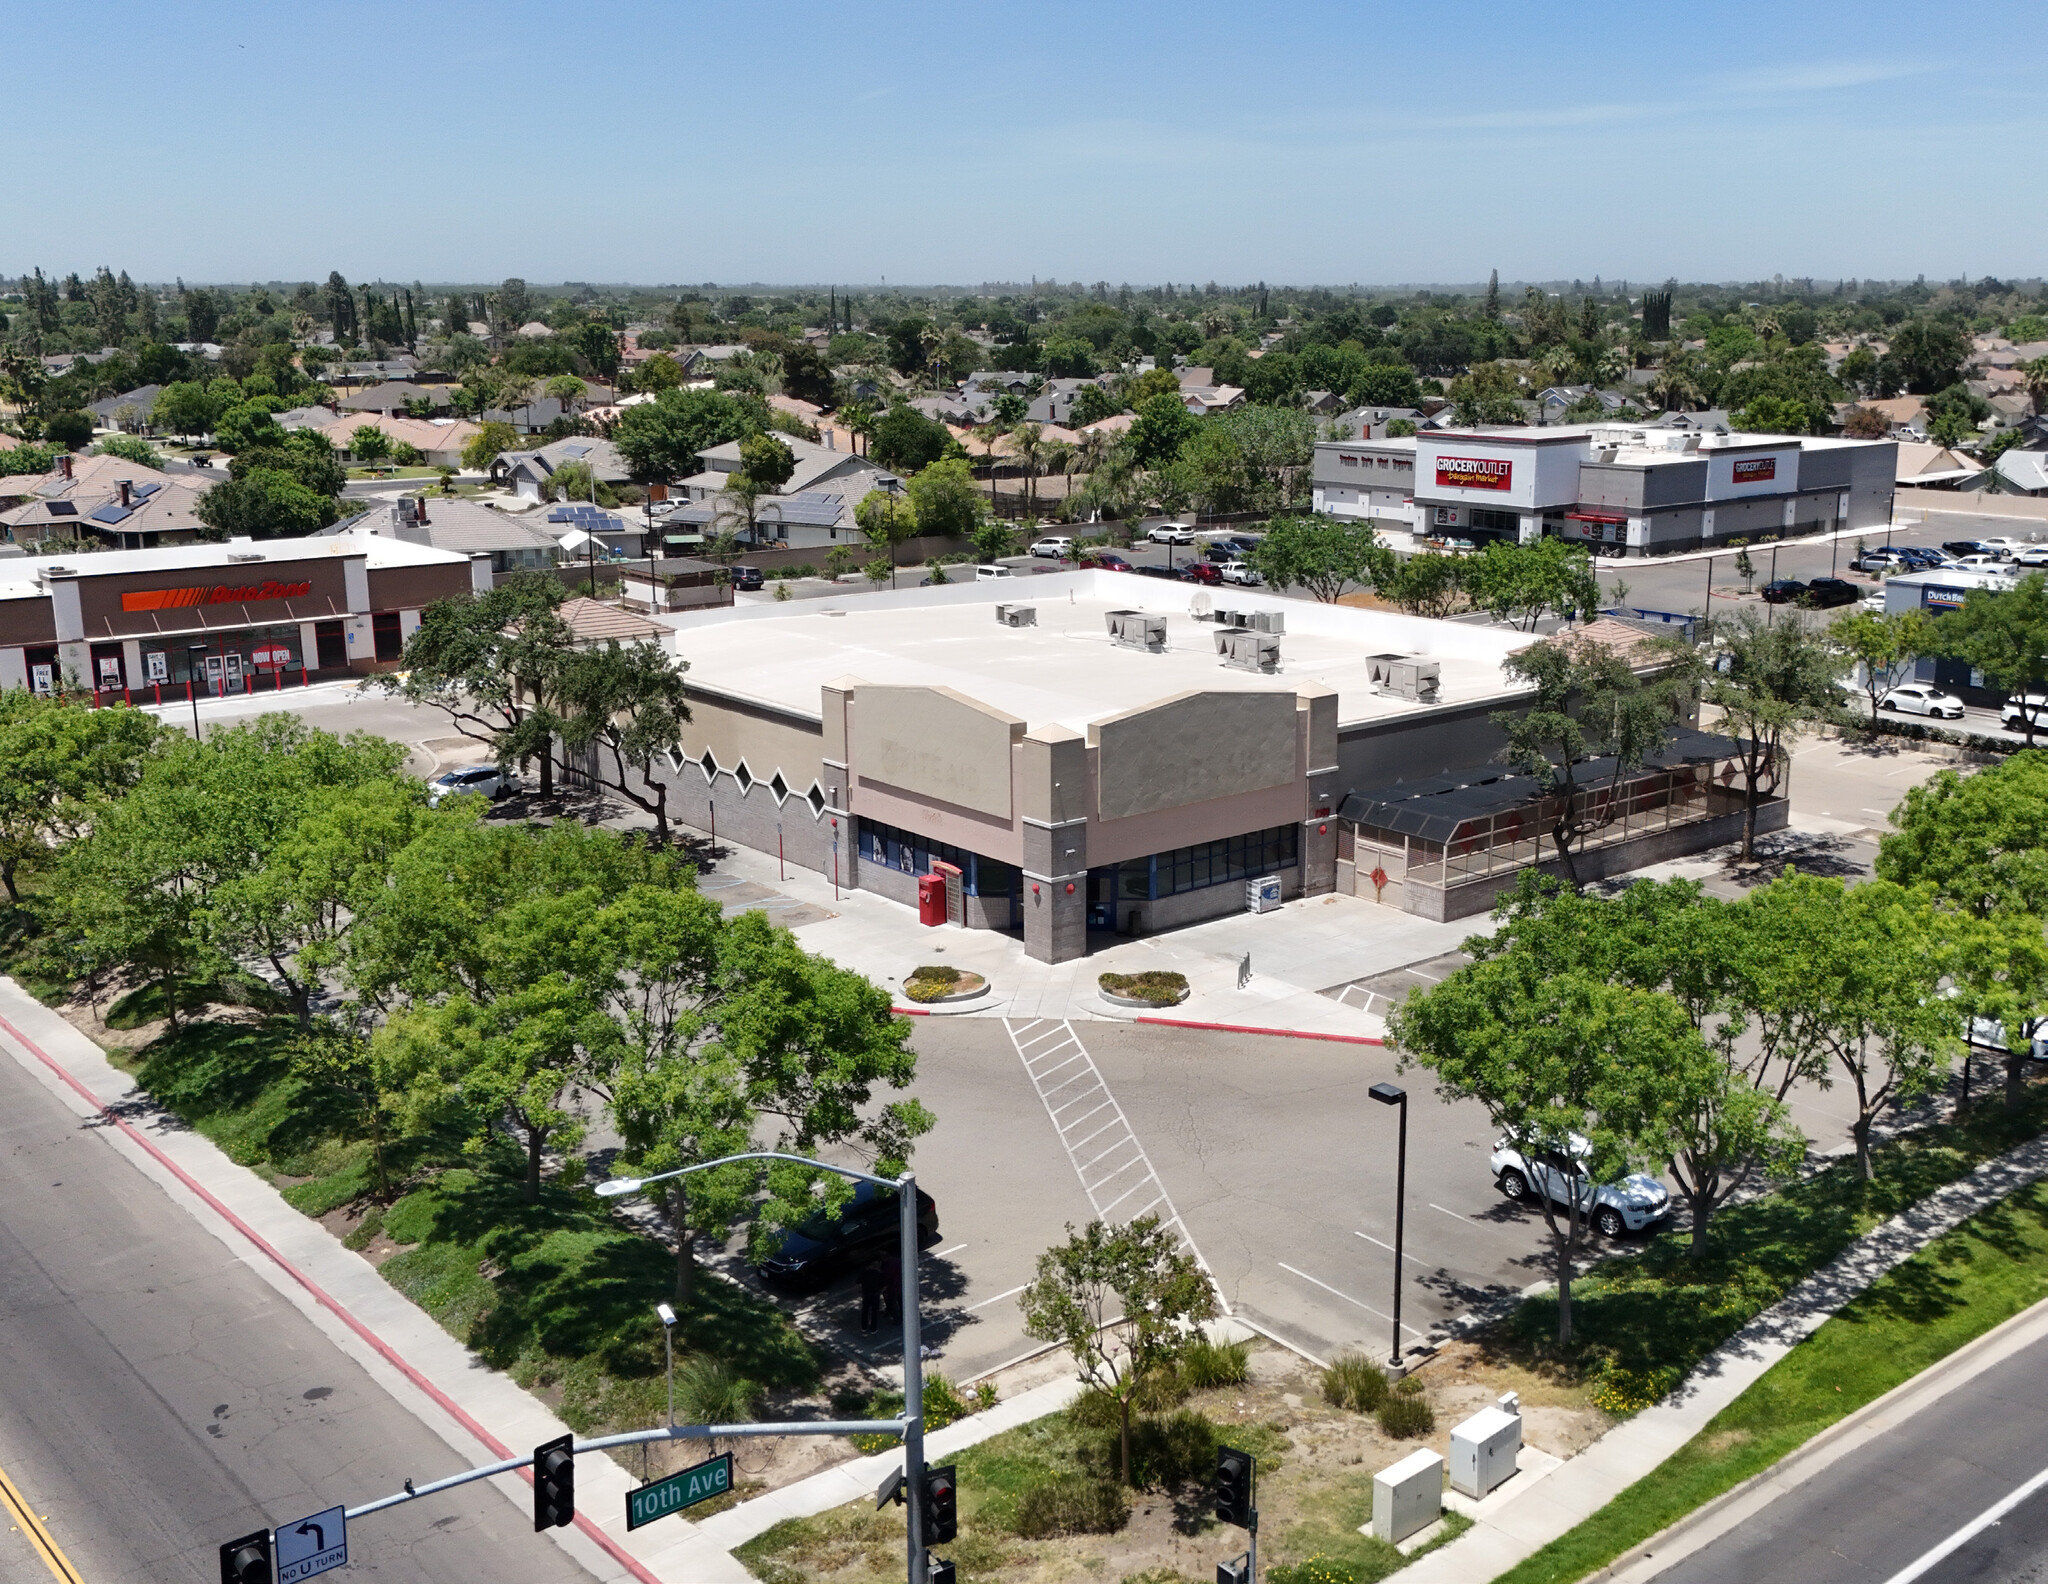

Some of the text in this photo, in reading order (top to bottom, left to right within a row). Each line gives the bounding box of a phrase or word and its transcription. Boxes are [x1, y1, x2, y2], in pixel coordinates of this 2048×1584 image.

[208, 581, 310, 604] AutoZone
[252, 649, 290, 664] NOW OPEN
[635, 1468, 727, 1519] 10th Ave
[282, 1551, 343, 1581] NO U TURN
